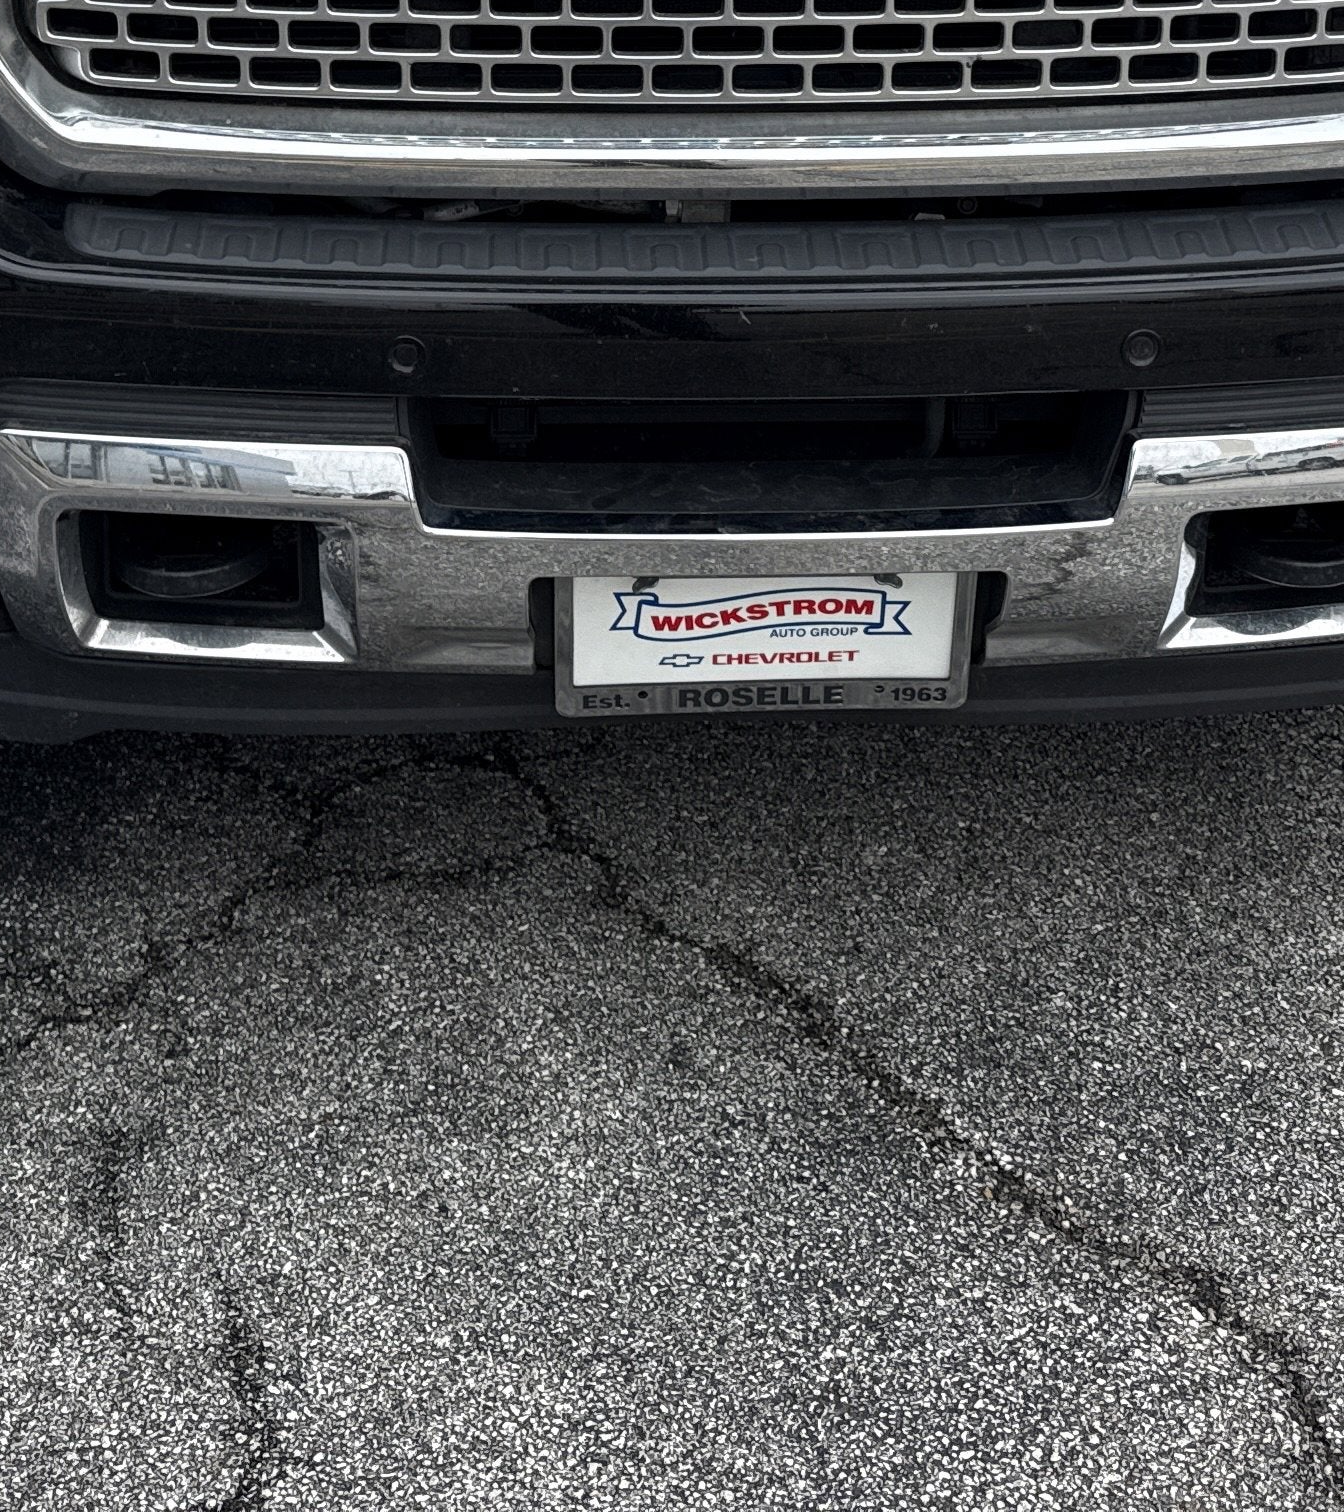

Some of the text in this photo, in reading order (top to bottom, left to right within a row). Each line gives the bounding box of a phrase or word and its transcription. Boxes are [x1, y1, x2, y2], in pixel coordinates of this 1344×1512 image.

[649, 598, 875, 633] WICKSTROM
[769, 626, 859, 639] AUTO GROUP
[711, 650, 860, 666] CHEVROLET
[582, 685, 948, 710] Est. ROSELLE 1963
